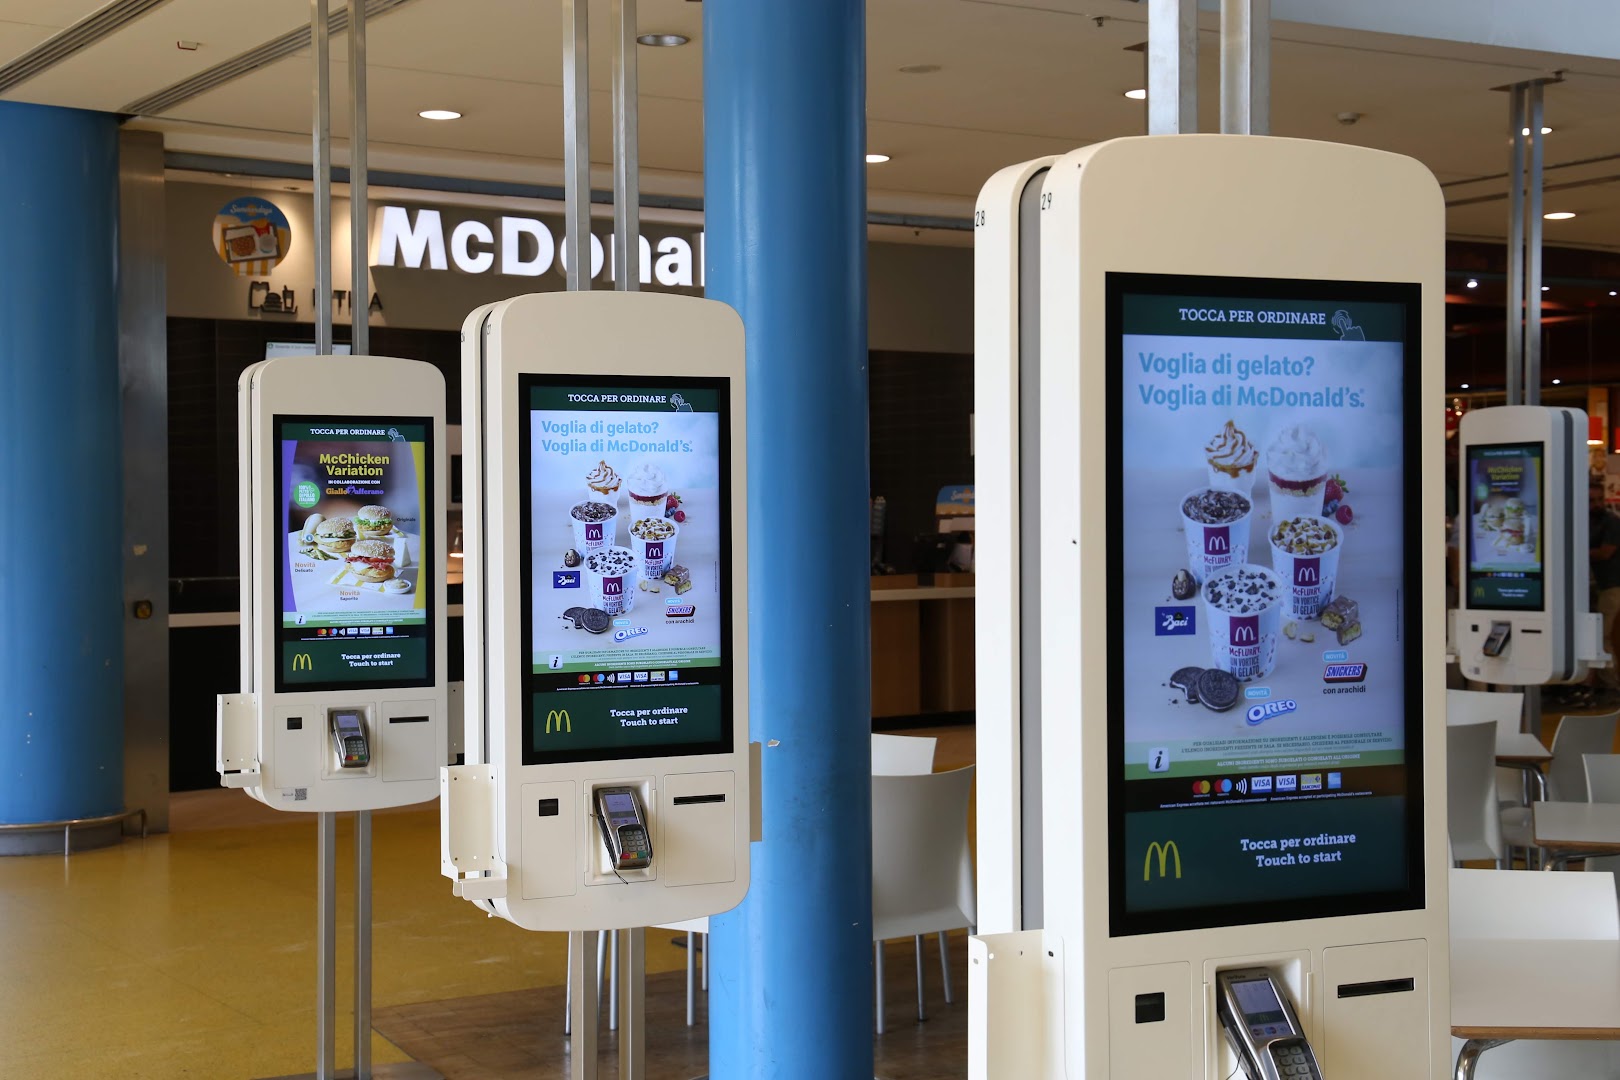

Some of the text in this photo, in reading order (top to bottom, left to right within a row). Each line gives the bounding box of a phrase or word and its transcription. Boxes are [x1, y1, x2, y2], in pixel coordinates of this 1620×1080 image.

[1042, 192, 1052, 210] 29
[976, 210, 985, 227] 28
[1179, 308, 1326, 325] TOCCA PER ORDINARE
[1139, 352, 1315, 381] Voglia di gelato?
[568, 394, 666, 403] TOCCA PER ORDINARE
[1139, 384, 1206, 411] Voglia
[1212, 384, 1231, 406] di
[542, 420, 659, 437] Voglia di gelato?
[542, 439, 587, 456] Voglia
[590, 439, 604, 452] di
[319, 453, 389, 464] McChicken
[326, 465, 383, 476] Variation
[1162, 614, 1188, 630] Baci
[616, 627, 648, 640] OREO
[373, 652, 401, 660] ordinare
[1238, 657, 1259, 667] VORTICE
[1238, 667, 1259, 678] GELATO
[1326, 665, 1362, 677] SNICKERS
[1337, 685, 1366, 694] arachidi
[610, 707, 688, 719] Tocca per ordinare
[1248, 700, 1296, 721] OREO
[620, 718, 647, 727] Touch
[1253, 779, 1270, 787] VISA
[1278, 777, 1295, 786] VISA
[1240, 833, 1356, 852] Tocca per ordinare
[1256, 850, 1342, 867] Touch to start
